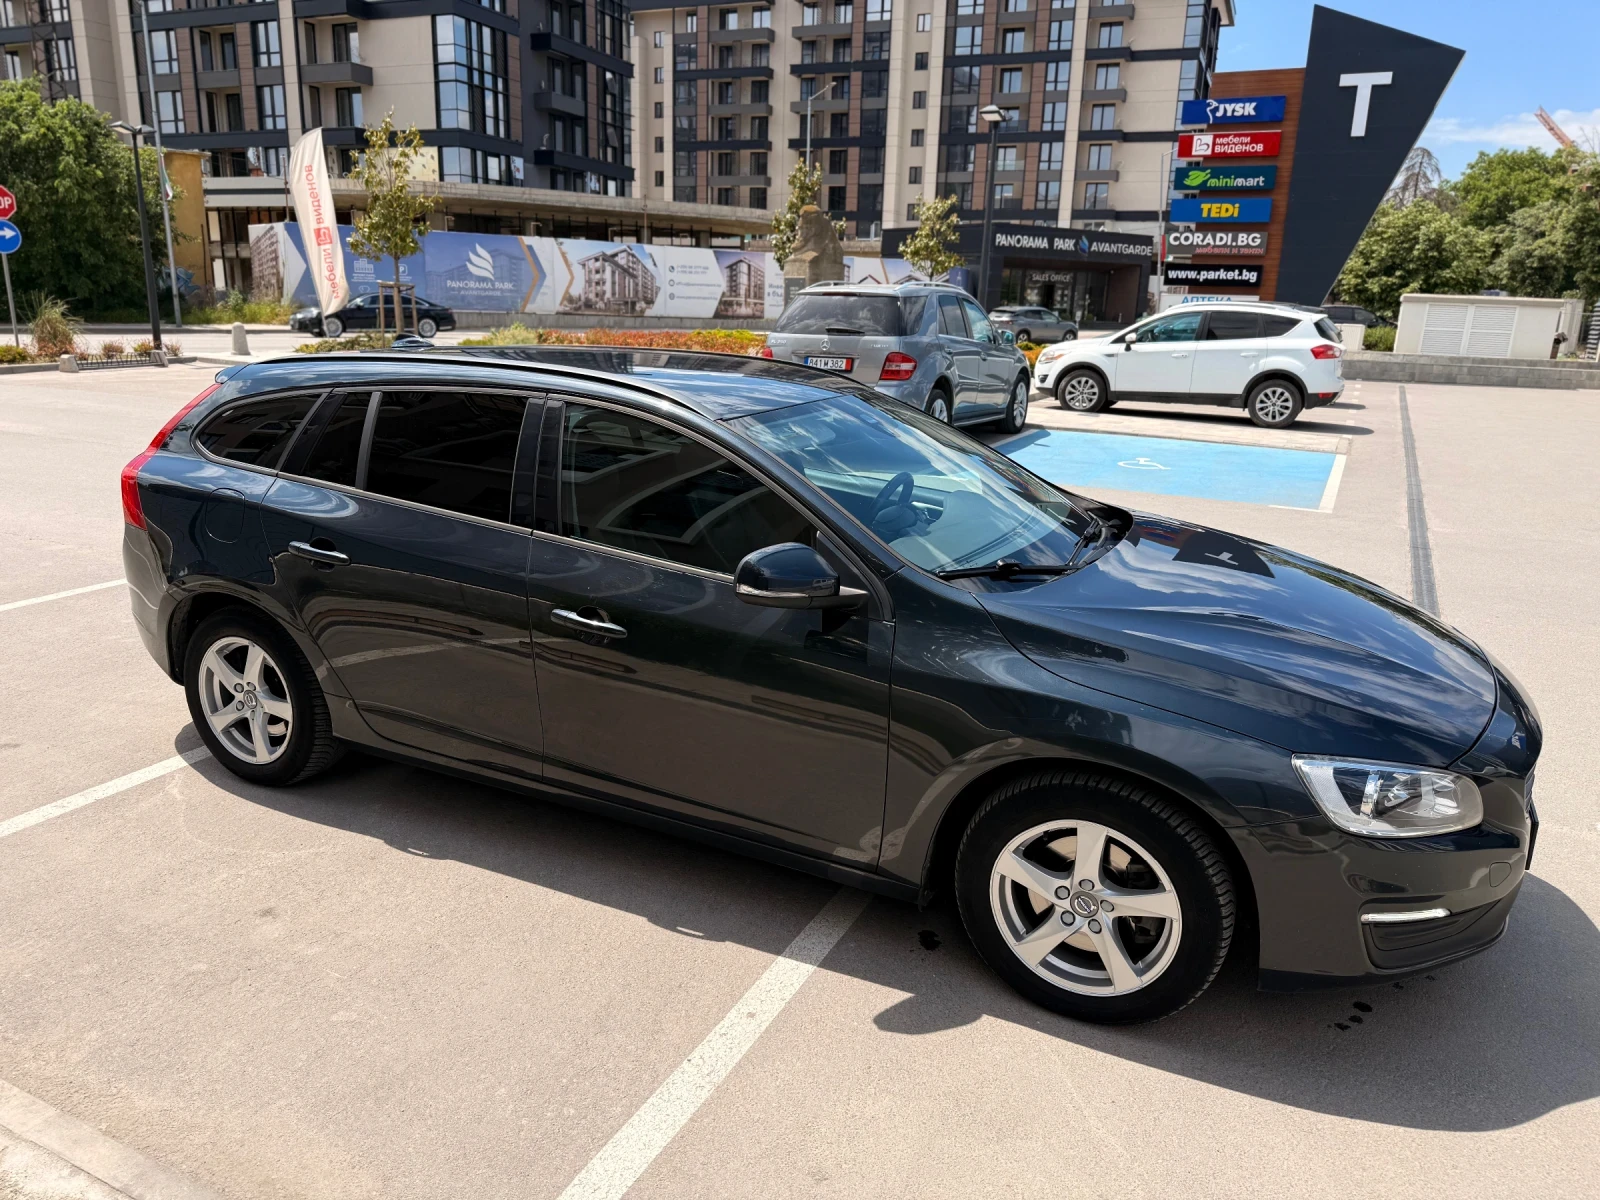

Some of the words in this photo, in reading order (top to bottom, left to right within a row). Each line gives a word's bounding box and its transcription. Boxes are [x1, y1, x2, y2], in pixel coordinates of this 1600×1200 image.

[1215, 102, 1257, 117] JYSK
[1338, 71, 1393, 137] T
[1215, 135, 1251, 144] мебели
[1206, 175, 1265, 187] minimart
[0, 197, 12, 209] OP
[1200, 203, 1240, 218] TEDi
[995, 233, 1049, 250] PANORAMA
[1053, 237, 1076, 251] PARK
[1090, 241, 1153, 256] AVANTGARDE
[1169, 232, 1262, 246] CORADI.BG
[323, 248, 340, 299] мебели
[1032, 273, 1049, 281] SALES
[1050, 274, 1070, 283] OFFICE
[1168, 269, 1258, 283] www.parket.bg
[446, 280, 493, 289] PANORAMA
[494, 281, 514, 289] PARK
